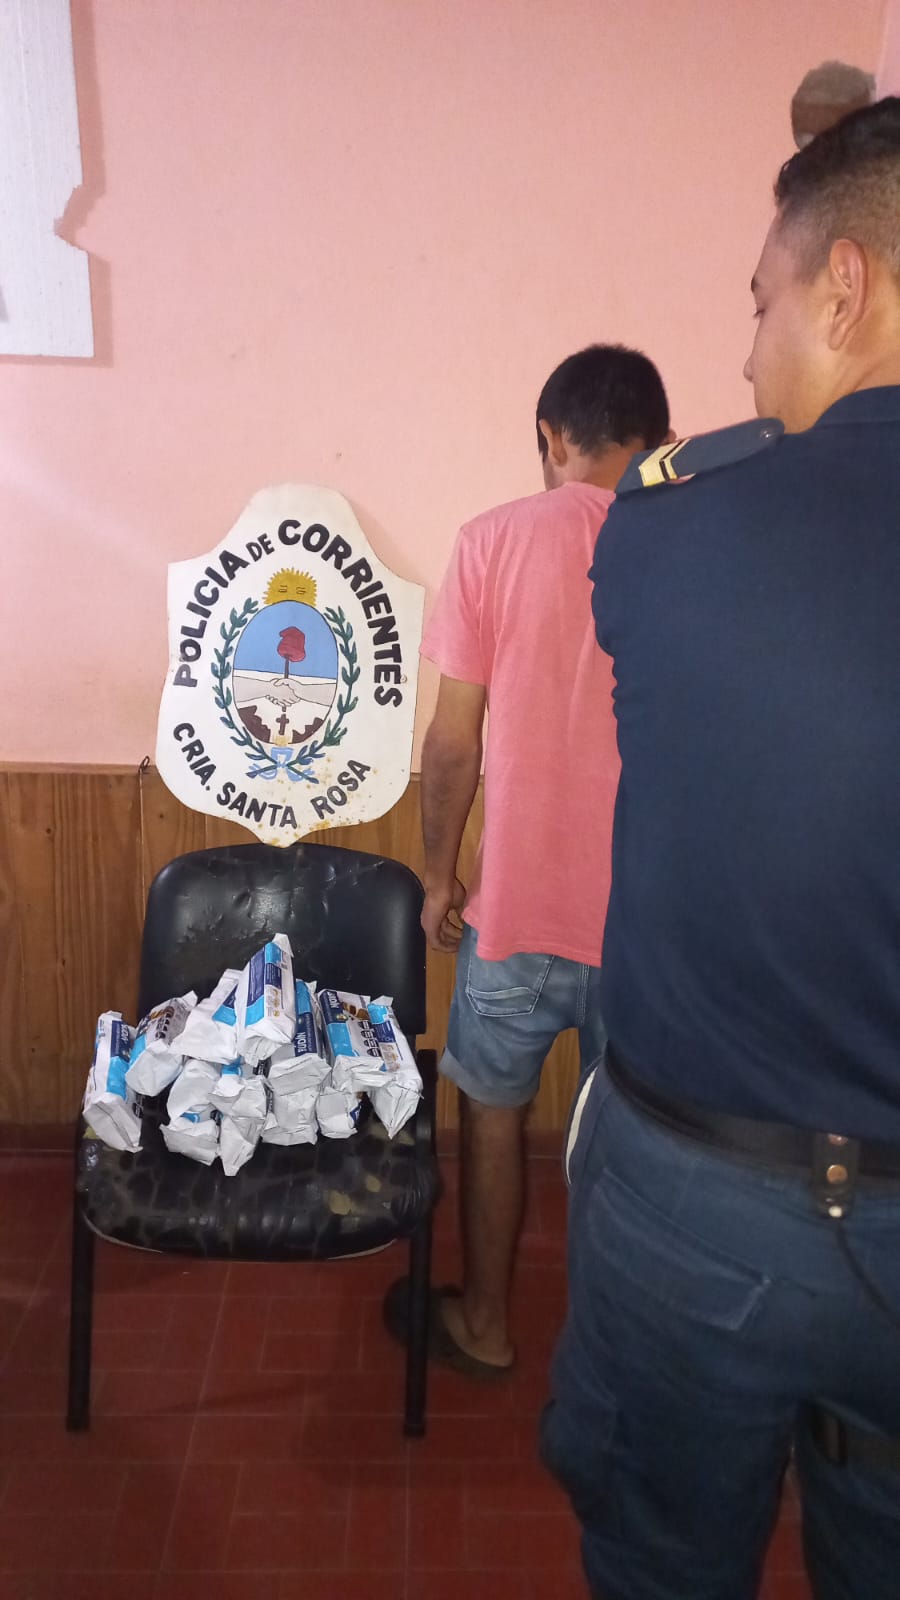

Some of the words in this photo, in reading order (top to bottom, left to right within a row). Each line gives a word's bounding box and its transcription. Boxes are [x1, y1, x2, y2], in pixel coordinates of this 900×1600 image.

[173, 549, 249, 688] POLICIA
[246, 533, 275, 562] DE
[278, 519, 402, 708] CORRIENTES
[173, 722, 217, 791] CRIA.
[216, 782, 298, 828] SANTA
[310, 759, 371, 820] ROSA
